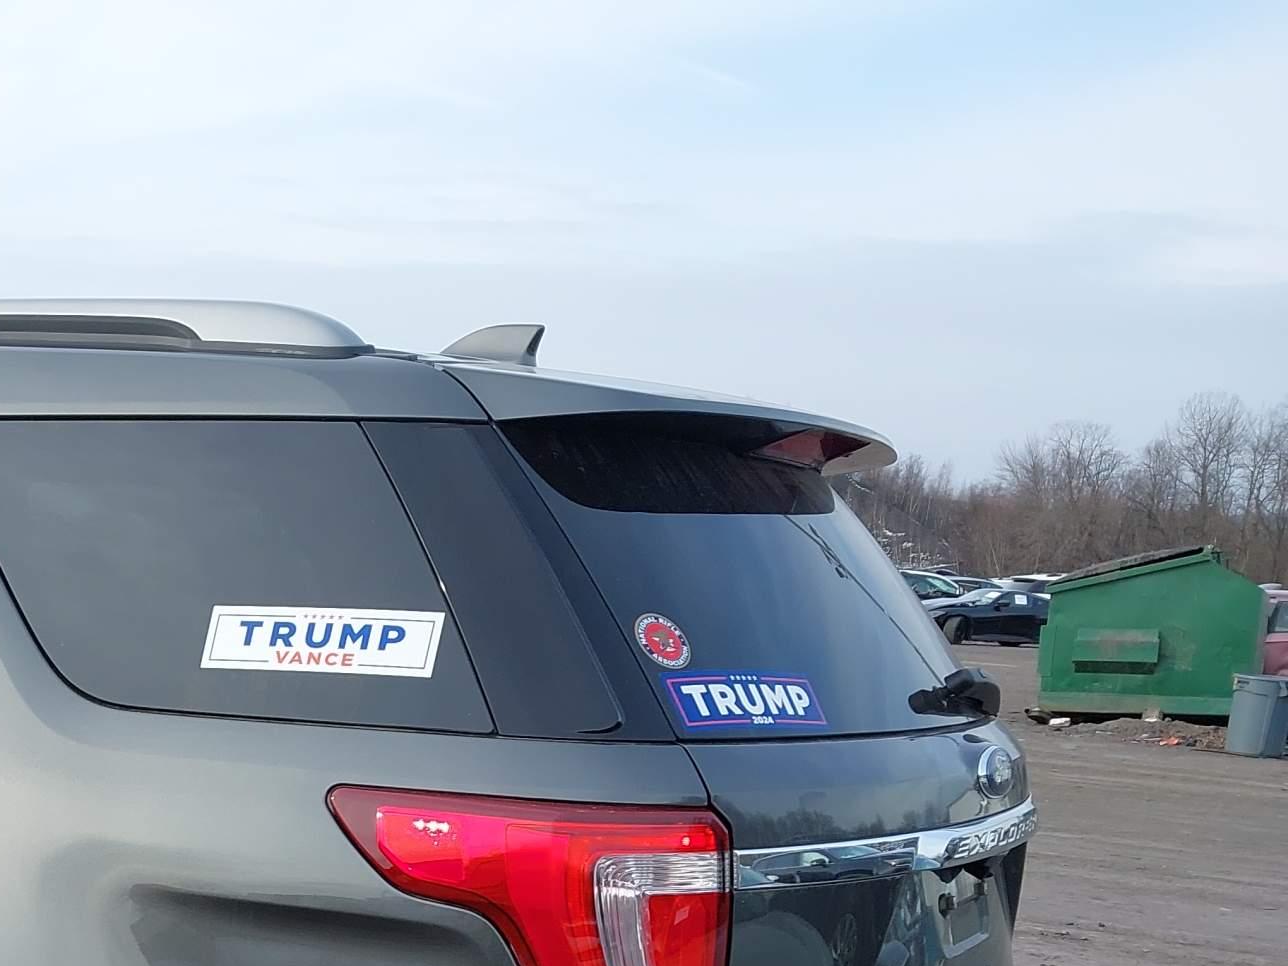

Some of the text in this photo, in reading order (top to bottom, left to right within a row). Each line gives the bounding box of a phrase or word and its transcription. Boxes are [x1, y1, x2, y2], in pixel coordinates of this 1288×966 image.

[240, 620, 407, 651] TRUMP
[274, 650, 356, 667] VANCE
[680, 683, 810, 717] TRUMP
[751, 715, 775, 725] 2024
